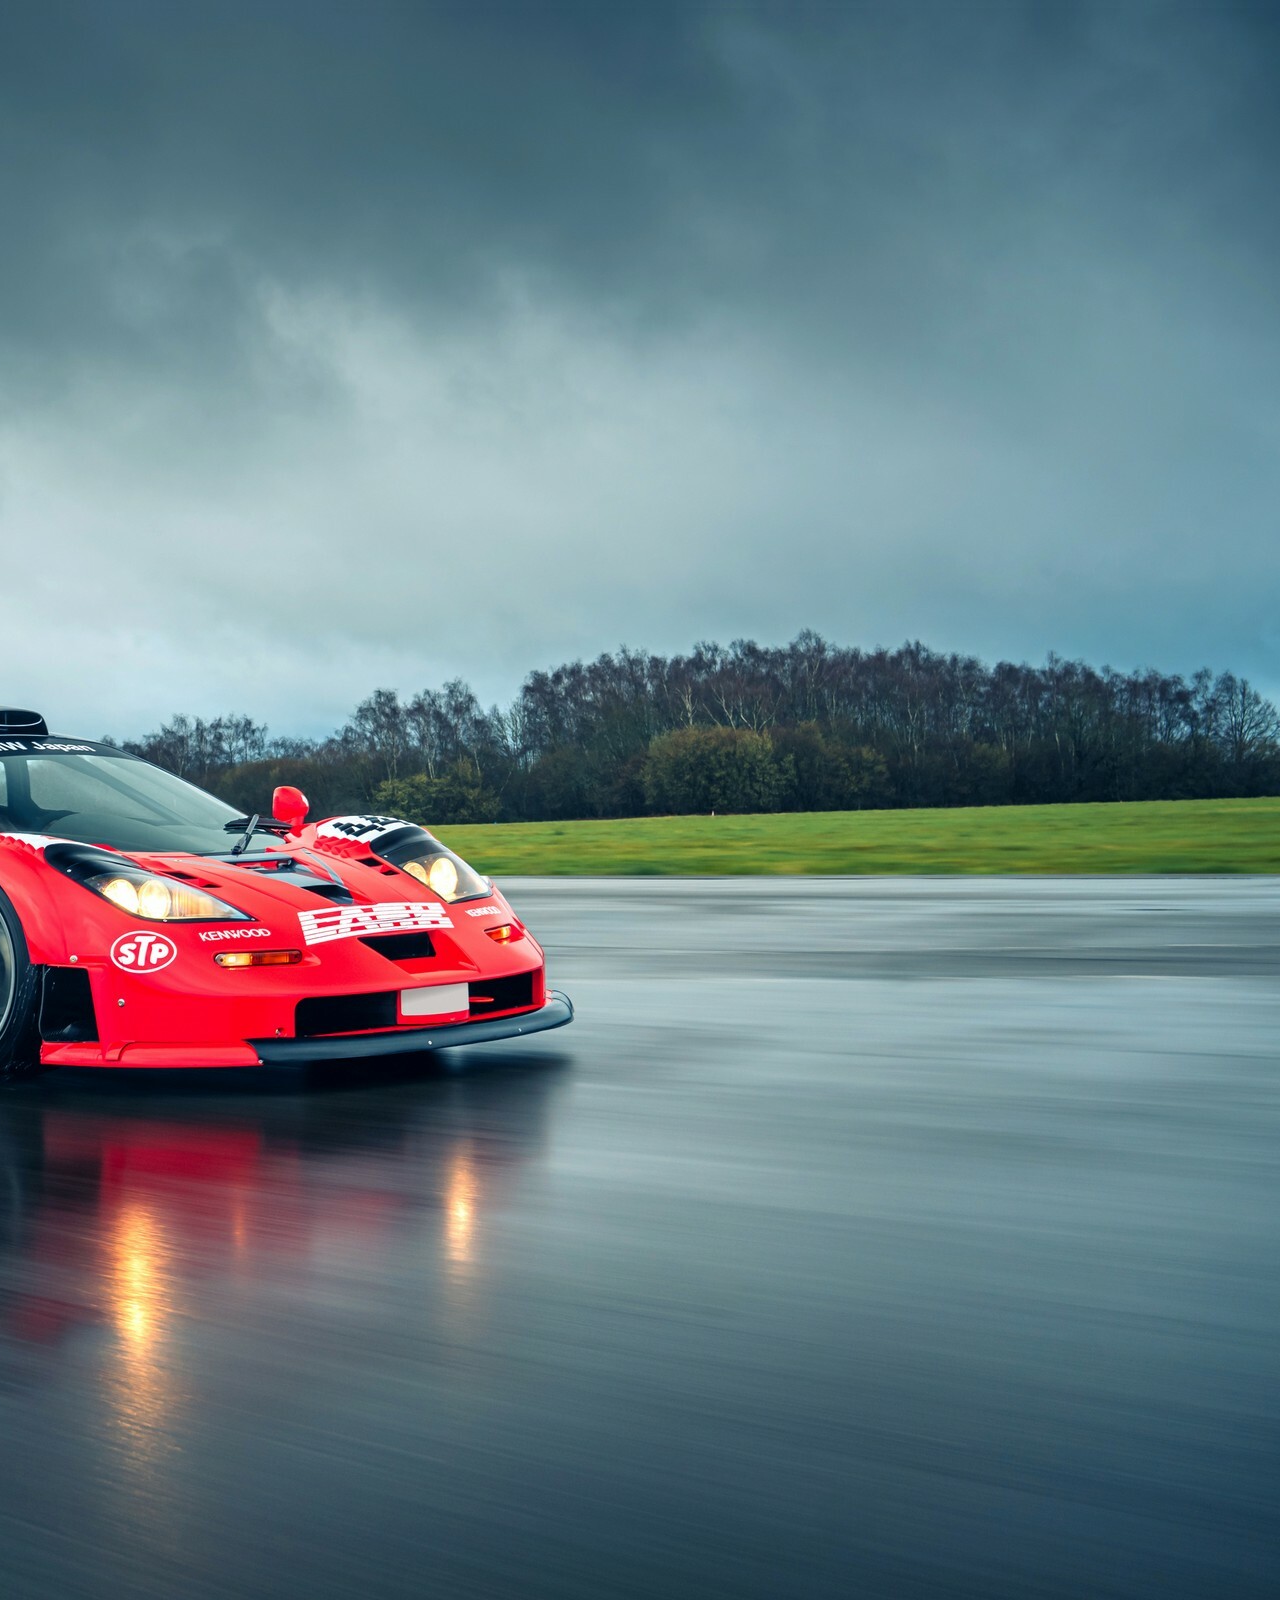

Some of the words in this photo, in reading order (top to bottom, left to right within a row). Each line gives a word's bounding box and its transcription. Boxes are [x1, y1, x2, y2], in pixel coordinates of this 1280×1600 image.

[32, 741, 96, 752] Japan
[199, 928, 271, 942] KENWOOD
[118, 936, 169, 966] STP
